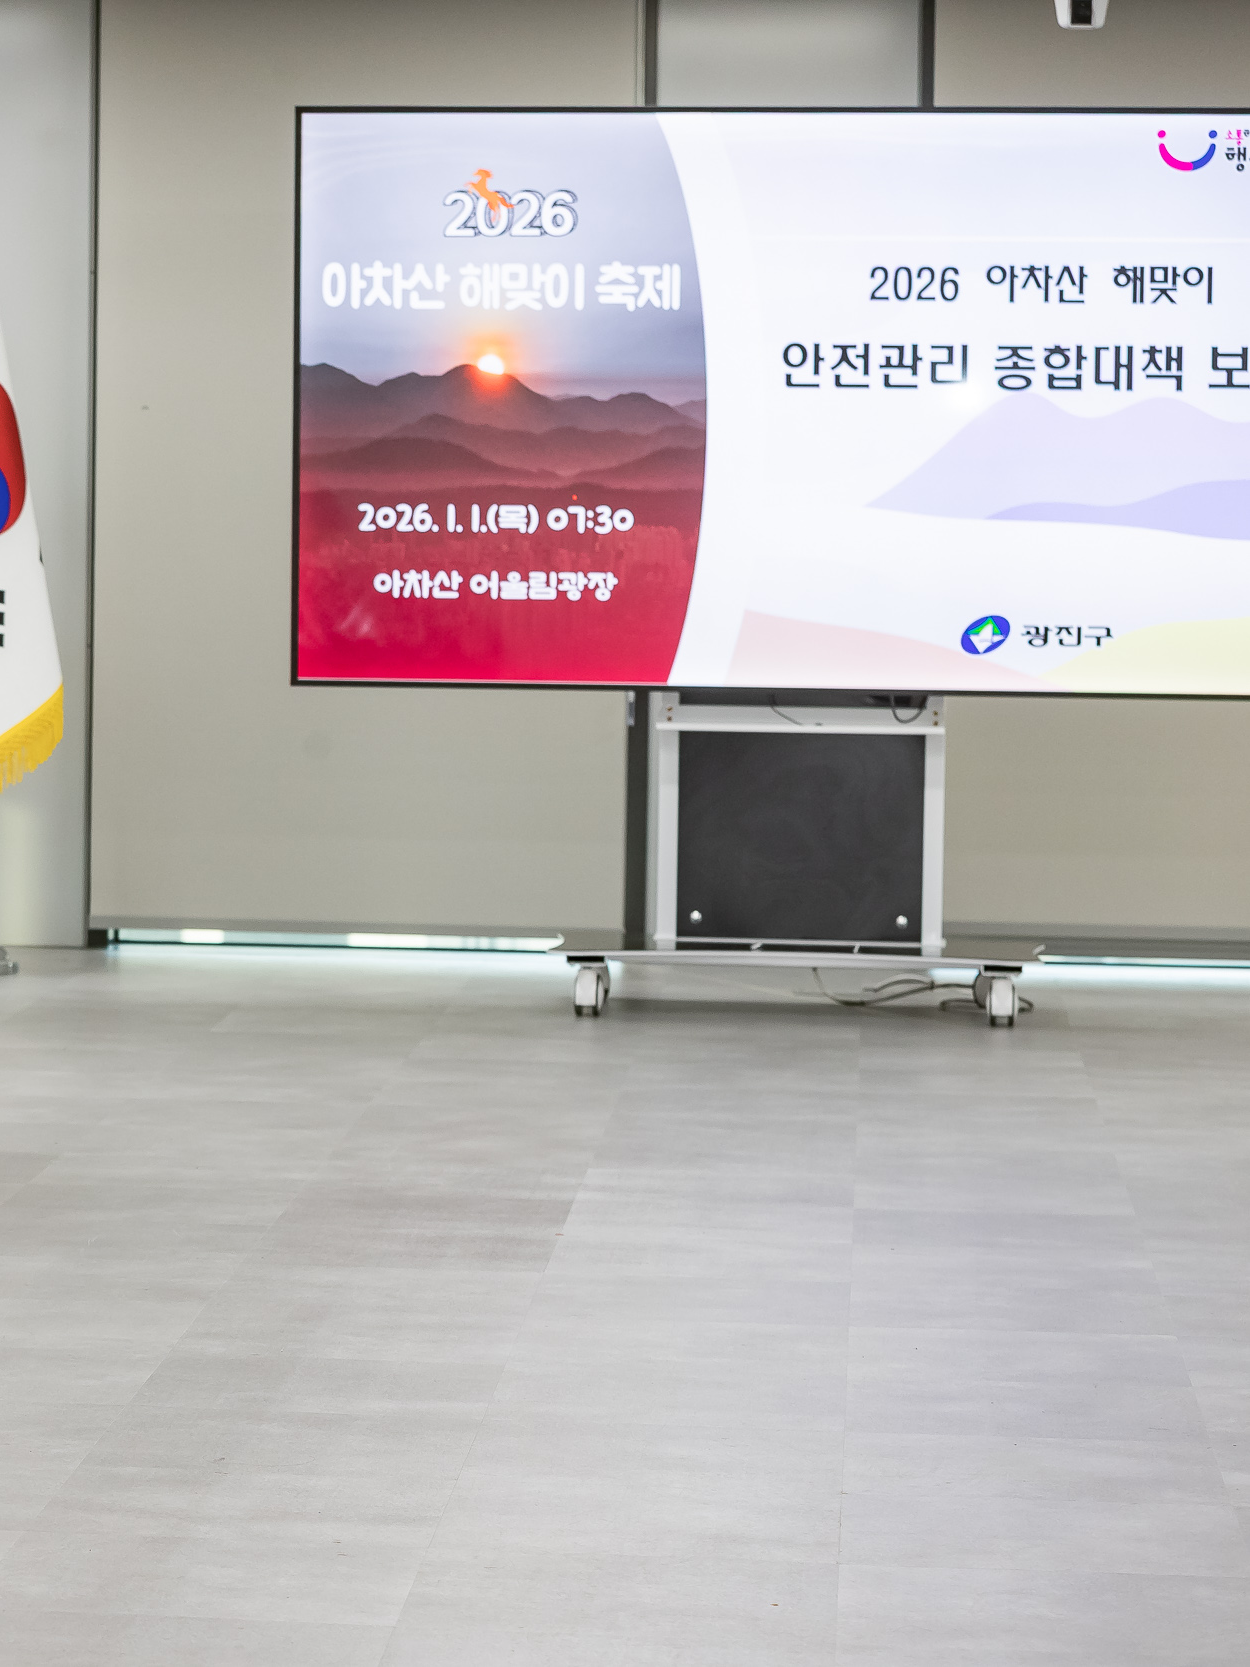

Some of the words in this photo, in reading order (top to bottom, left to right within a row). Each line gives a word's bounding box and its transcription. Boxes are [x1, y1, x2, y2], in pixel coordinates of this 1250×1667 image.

[443, 189, 579, 238] 2026
[322, 260, 449, 311] 아차산
[458, 262, 586, 311] 해맞이
[595, 261, 681, 312] 축제
[869, 265, 961, 303] 2026
[985, 264, 1088, 305] 아차산
[1112, 265, 1214, 305] 해맞이
[781, 342, 969, 390] 안전관리
[993, 344, 1184, 392] 종합대책
[357, 503, 440, 534] 2026.
[546, 505, 636, 535] 07:30
[373, 570, 463, 600] 아차산
[469, 570, 619, 602] 어울림광장
[1020, 625, 1114, 648] 광진구
